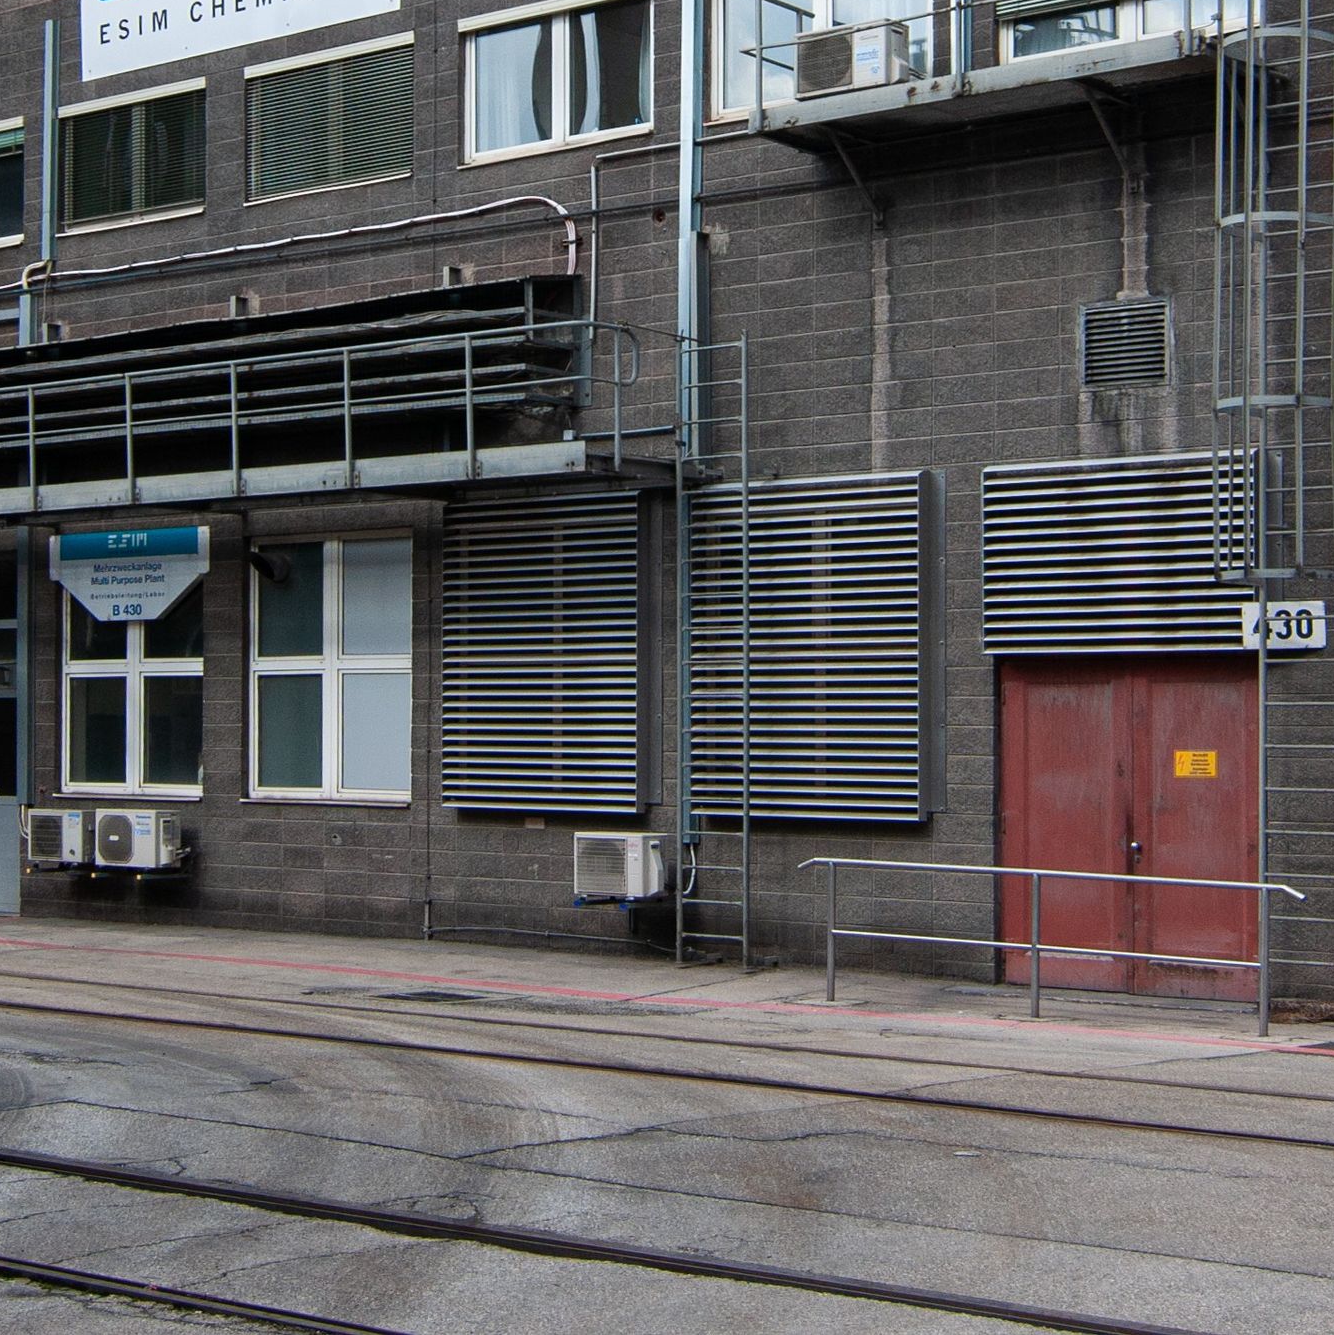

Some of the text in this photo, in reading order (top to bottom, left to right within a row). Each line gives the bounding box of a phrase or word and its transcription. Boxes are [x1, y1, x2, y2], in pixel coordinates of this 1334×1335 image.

[100, 9, 169, 45] ESIM
[108, 533, 147, 548] ESIM
[93, 562, 162, 573] Mehrzweckanlage
[91, 574, 165, 585] Multi Purpose Plant
[113, 603, 142, 616] B 430
[1253, 609, 1313, 640] 430
